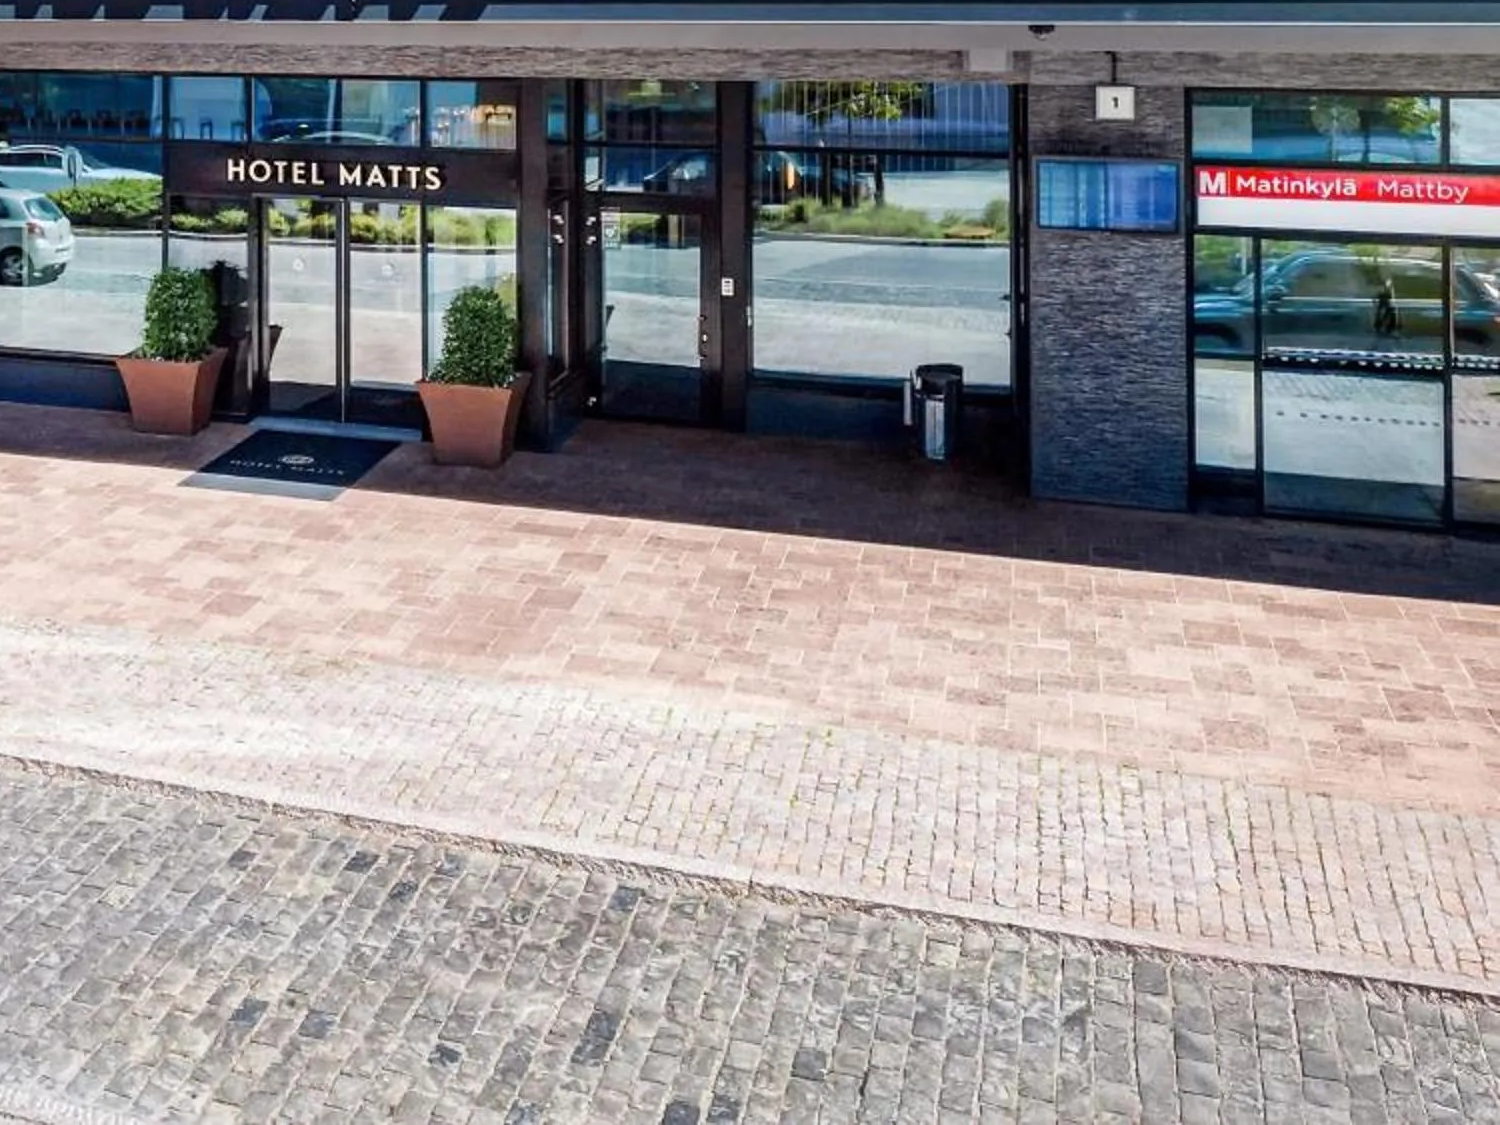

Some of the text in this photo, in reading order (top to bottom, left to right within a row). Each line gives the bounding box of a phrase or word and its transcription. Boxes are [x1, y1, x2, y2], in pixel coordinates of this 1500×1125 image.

[1112, 96, 1119, 109] 1
[227, 159, 442, 191] HOTEL MATTS
[1200, 171, 1469, 204] M Matinkylä Mattby
